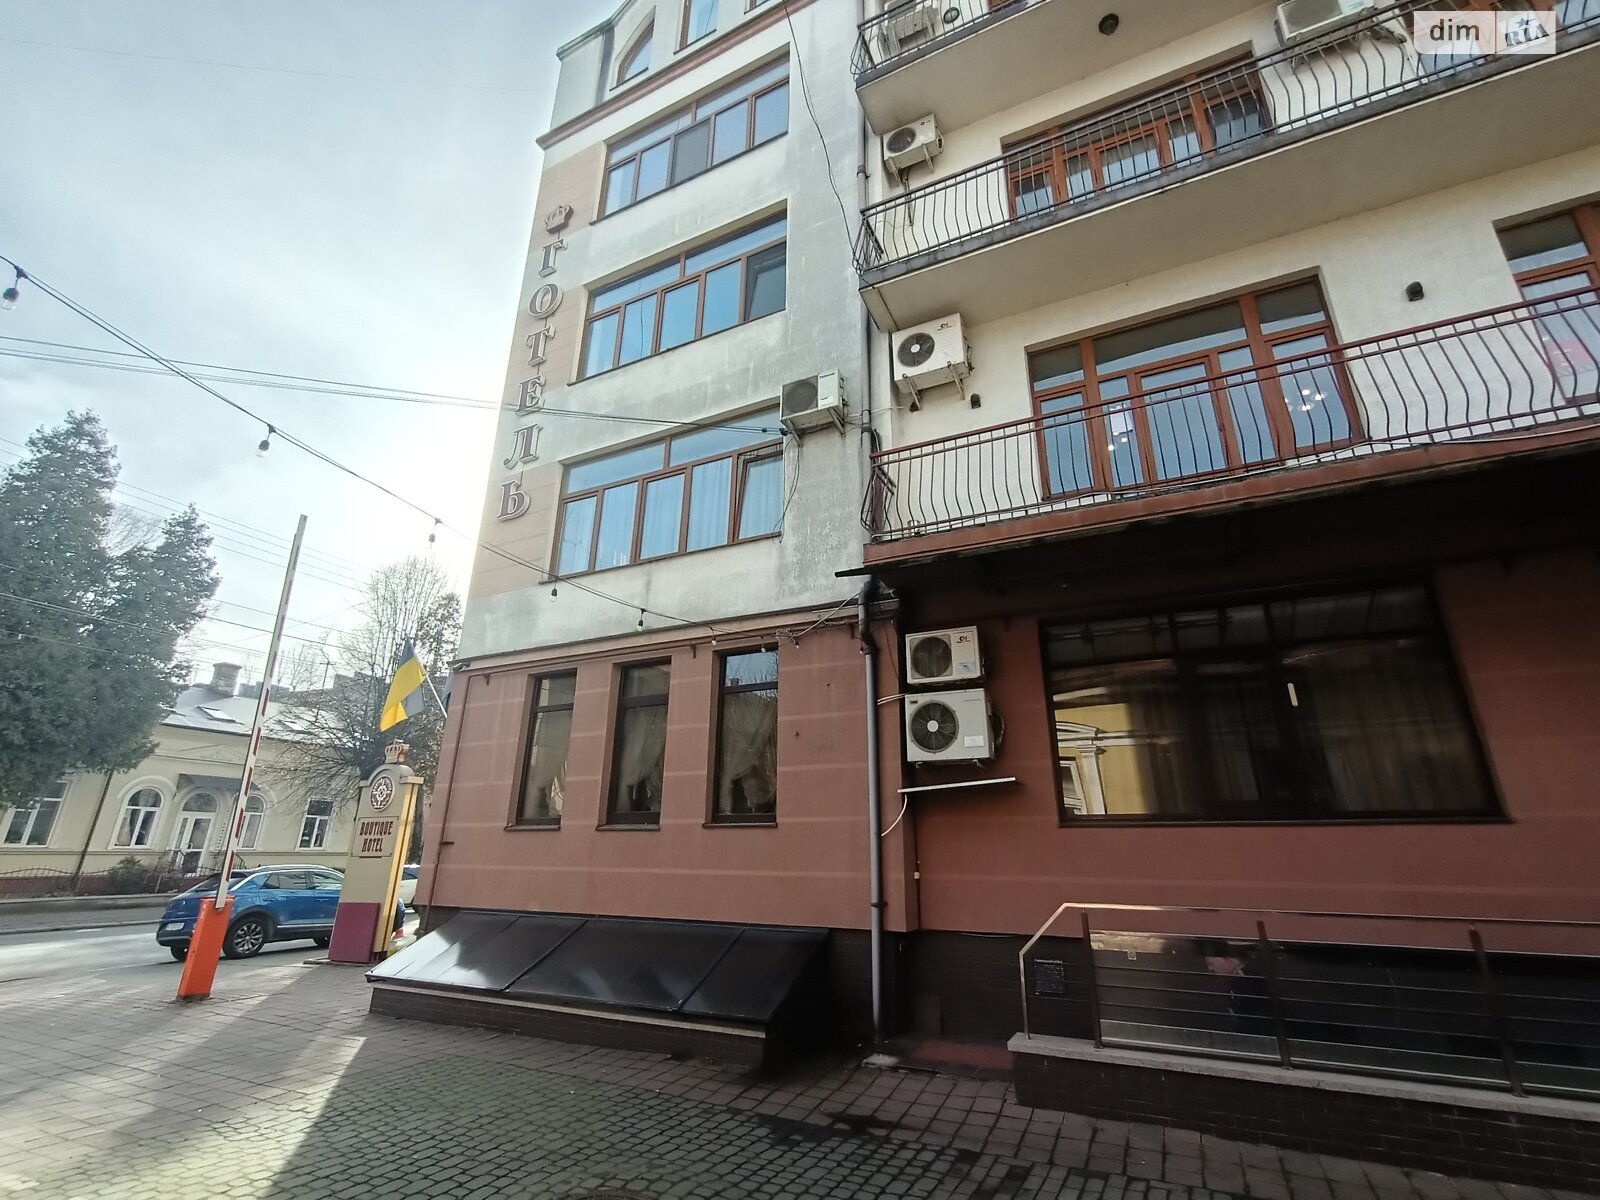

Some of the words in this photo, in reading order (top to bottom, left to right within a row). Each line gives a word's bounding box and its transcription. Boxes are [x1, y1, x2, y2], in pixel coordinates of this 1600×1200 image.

[496, 238, 569, 522] ГОТЕЛЬ
[359, 820, 394, 836] BOUTIQUE
[361, 837, 383, 852] HOTEL
